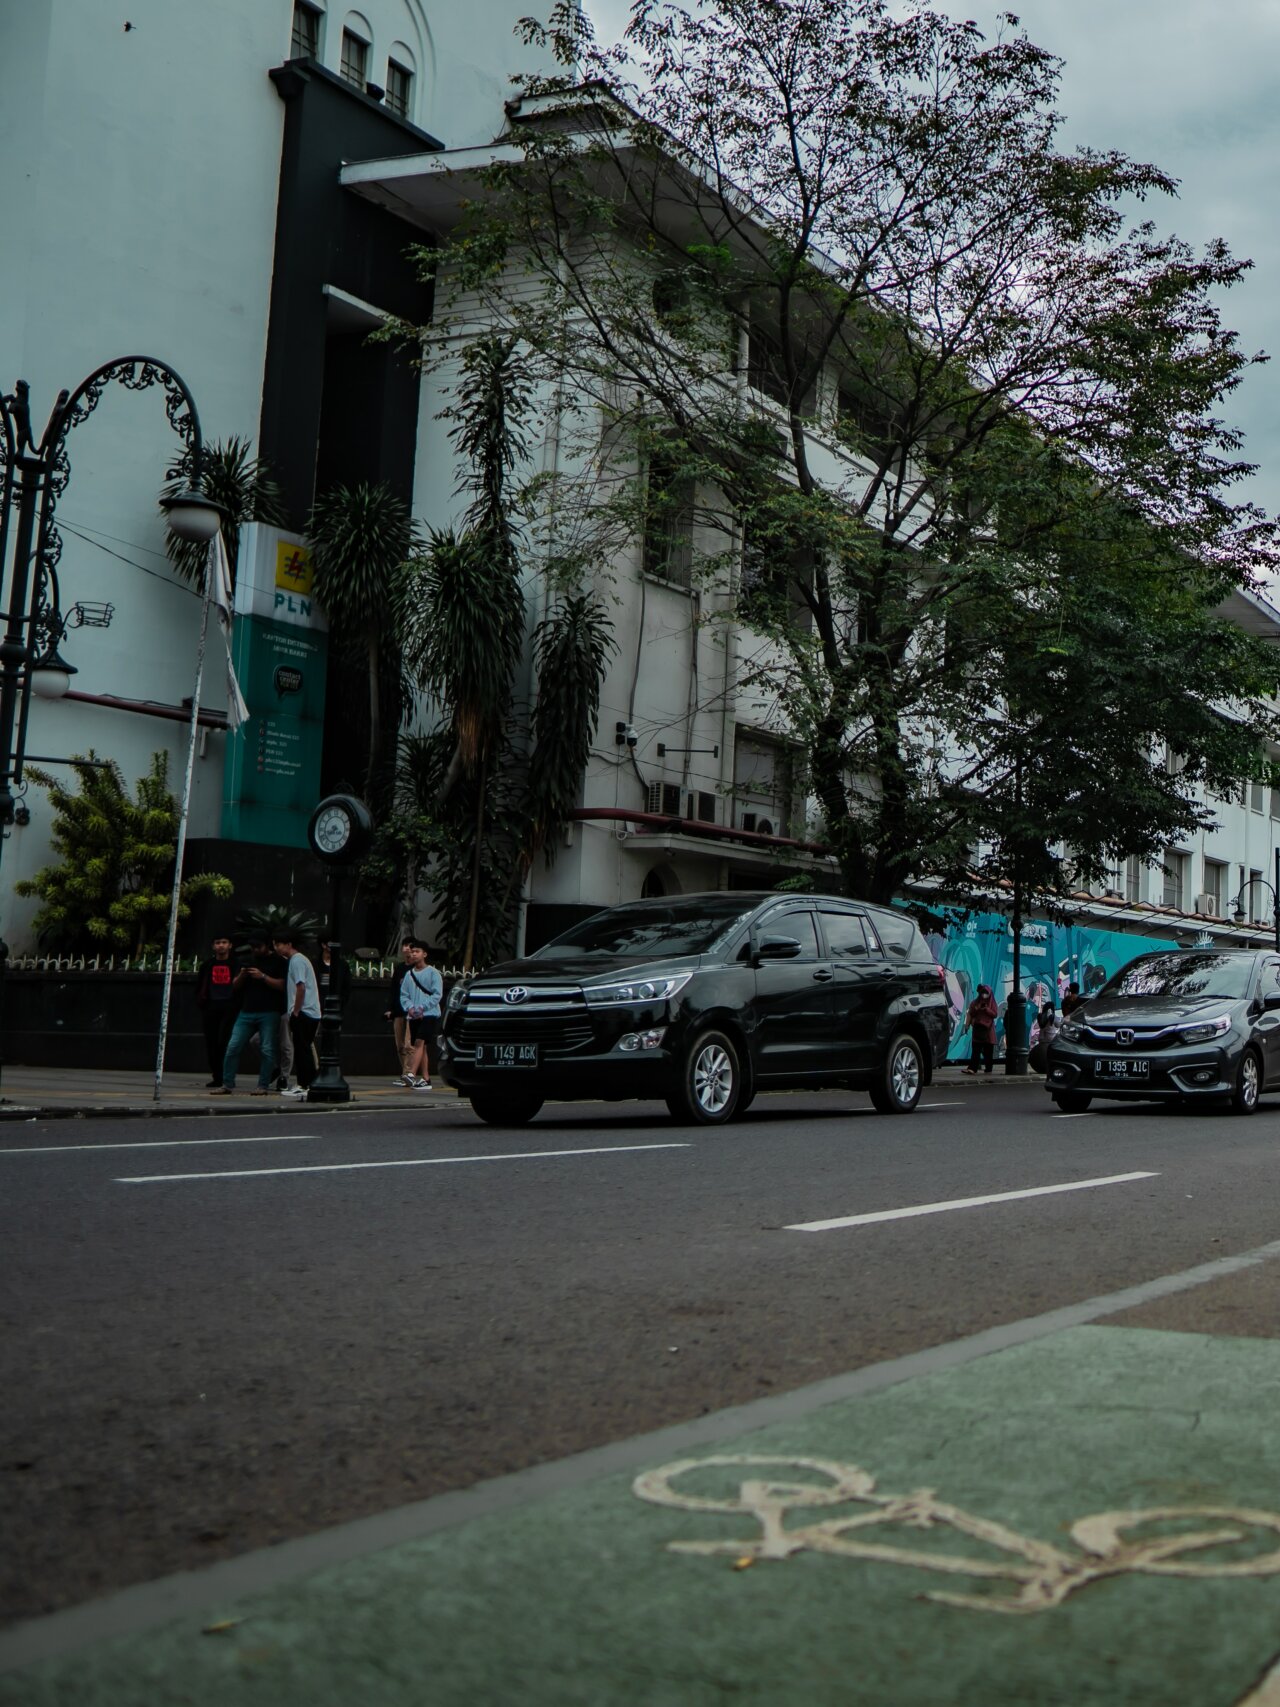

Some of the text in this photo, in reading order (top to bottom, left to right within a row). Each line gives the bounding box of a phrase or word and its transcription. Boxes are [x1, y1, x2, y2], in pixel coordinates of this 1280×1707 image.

[274, 592, 312, 617] PLN
[477, 1046, 536, 1059] D 1149 AGK
[1096, 1060, 1147, 1072] D 1355 AIC
